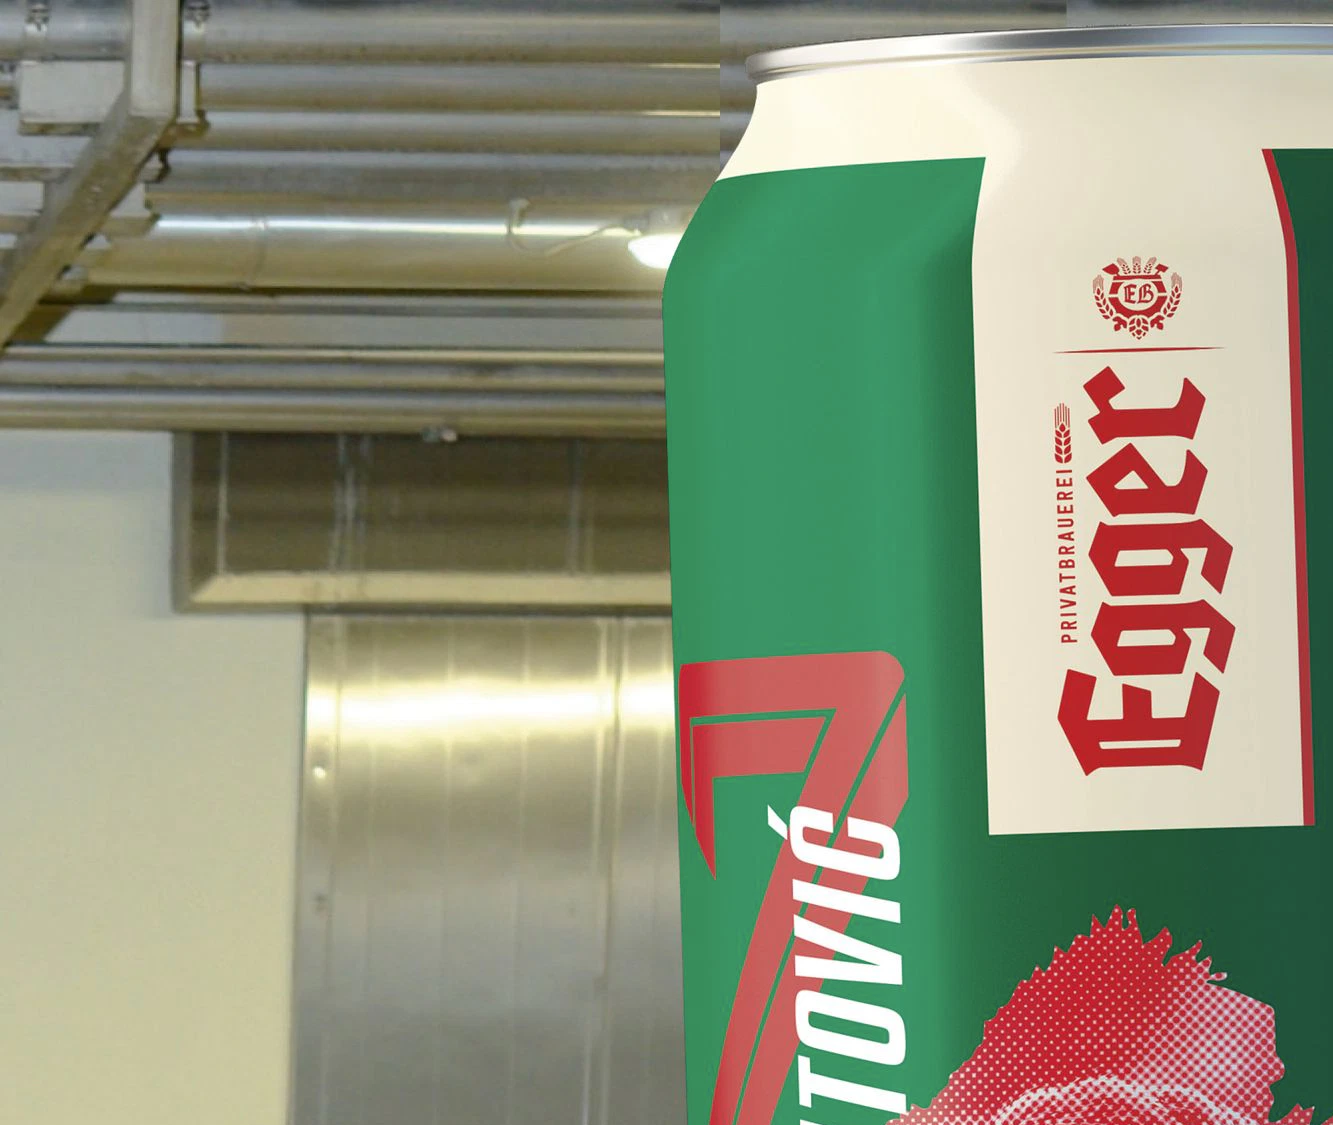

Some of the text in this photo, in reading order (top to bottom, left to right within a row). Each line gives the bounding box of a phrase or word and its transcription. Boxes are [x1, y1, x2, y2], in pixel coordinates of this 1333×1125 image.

[1123, 283, 1155, 304] EB
[1056, 469, 1078, 645] PRIVATBRAUEREI
[1056, 366, 1236, 777] Egger
